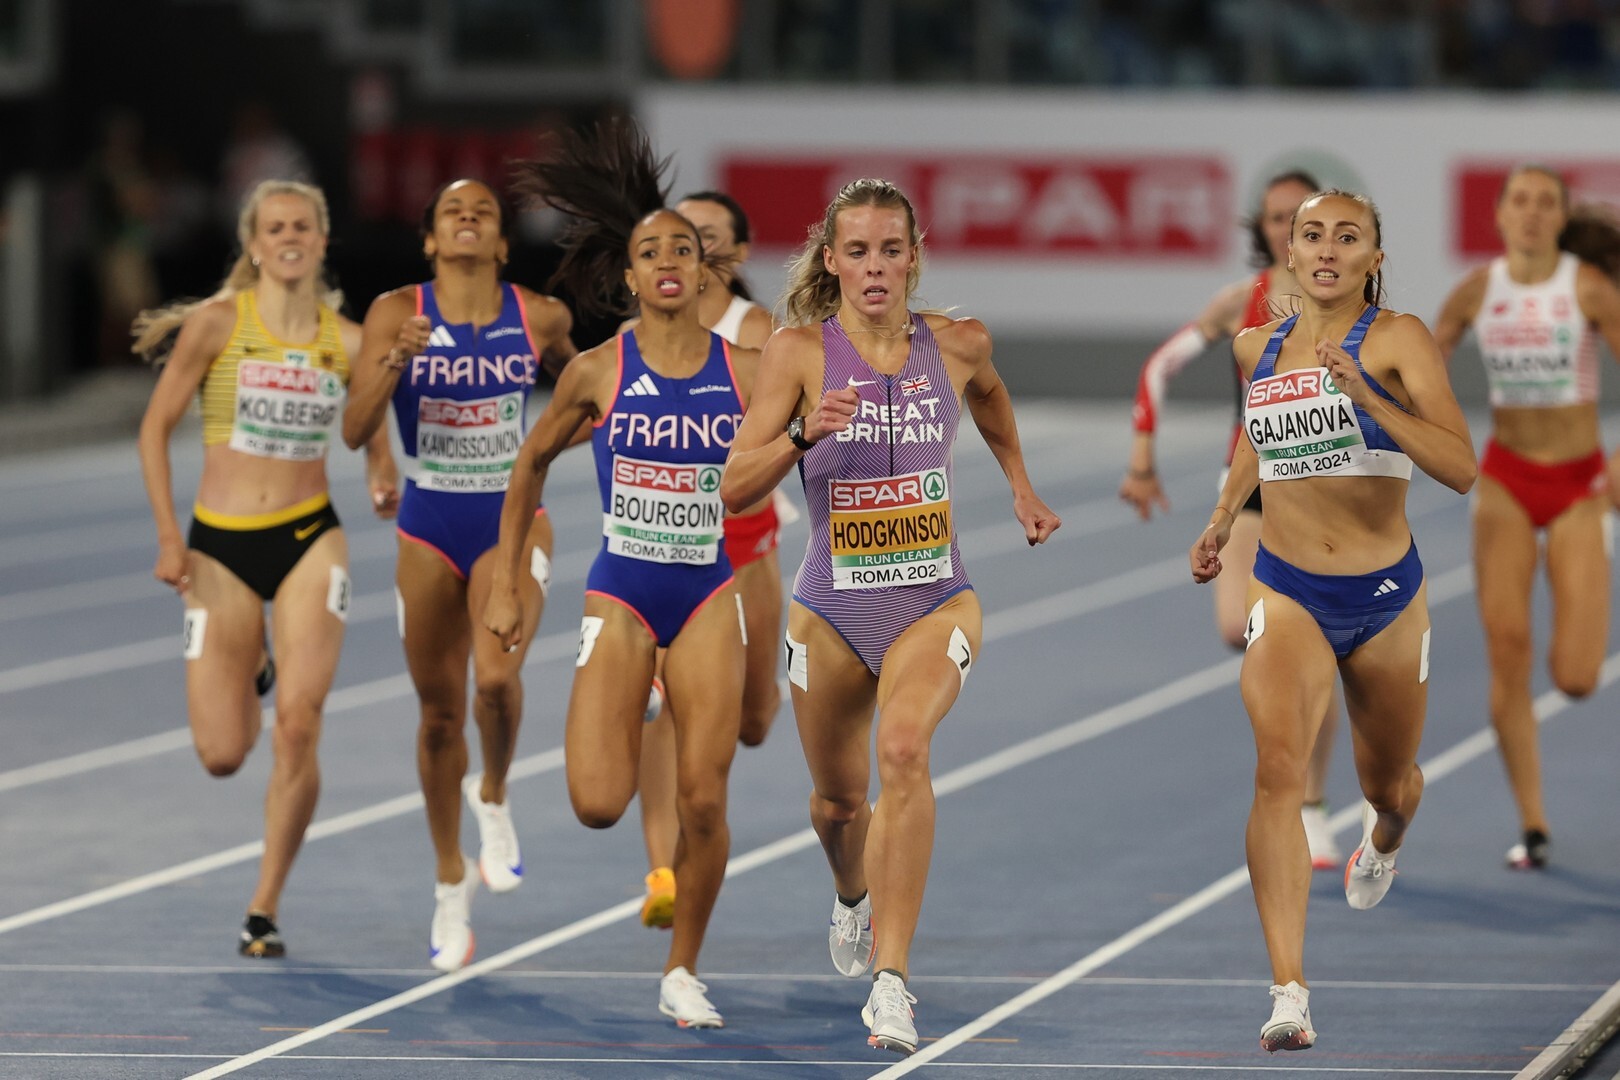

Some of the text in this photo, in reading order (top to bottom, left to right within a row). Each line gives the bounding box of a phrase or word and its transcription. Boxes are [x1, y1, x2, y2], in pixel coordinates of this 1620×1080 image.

[242, 365, 316, 393] SPAR
[411, 354, 536, 386] FRANCE
[1250, 375, 1318, 404] SPAR
[239, 397, 337, 426] KOLBERG
[423, 402, 496, 426] SPAR
[1250, 399, 1355, 445] GAJANOVÁ
[836, 422, 944, 444] BRITAIN
[616, 462, 695, 490] SPAR
[1273, 451, 1351, 476] ROMA 2024
[432, 475, 476, 488] ROMA
[834, 480, 919, 507] SPAR
[614, 494, 719, 528] BOURGOIN
[636, 530, 659, 540] RUN
[834, 511, 948, 549] HODGKINSON
[622, 541, 705, 560] ROMA 2024
[865, 554, 891, 565] RUN
[852, 564, 938, 584] ROMA 202
